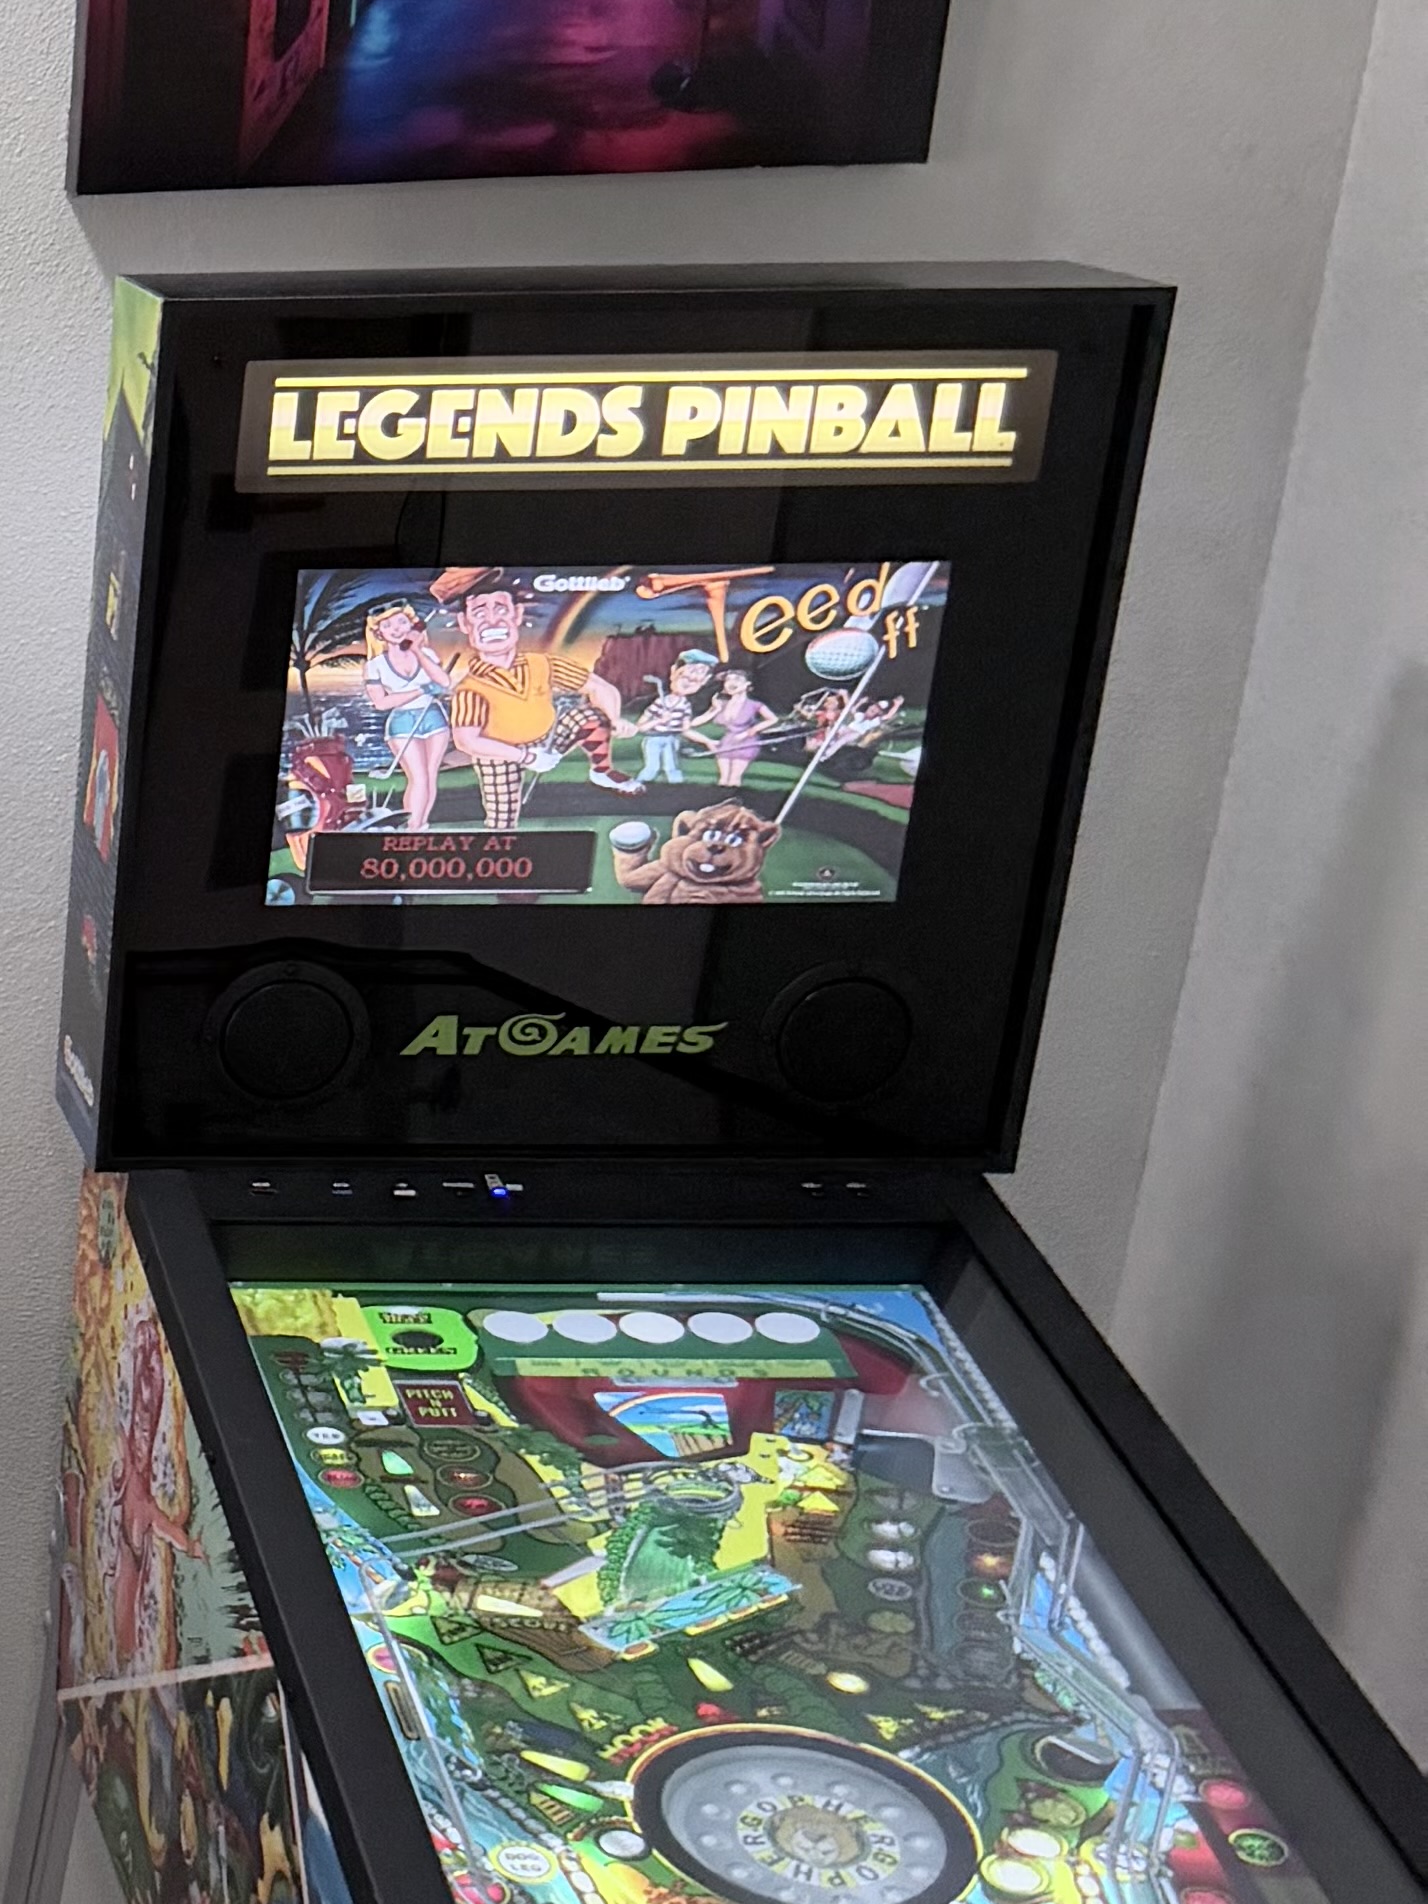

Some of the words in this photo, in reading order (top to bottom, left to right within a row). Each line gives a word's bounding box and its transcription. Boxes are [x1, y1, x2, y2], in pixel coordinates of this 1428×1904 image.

[268, 384, 645, 461] LEGENDS
[661, 381, 1019, 456] PINBALL
[382, 836, 475, 852] REPLAY
[483, 835, 518, 851] AT
[360, 856, 534, 882] 80,000,000
[405, 1388, 454, 1400] PITCH
[418, 1405, 458, 1418] PUTT
[505, 1851, 542, 1862] DOG
[509, 1863, 543, 1874] LEG
